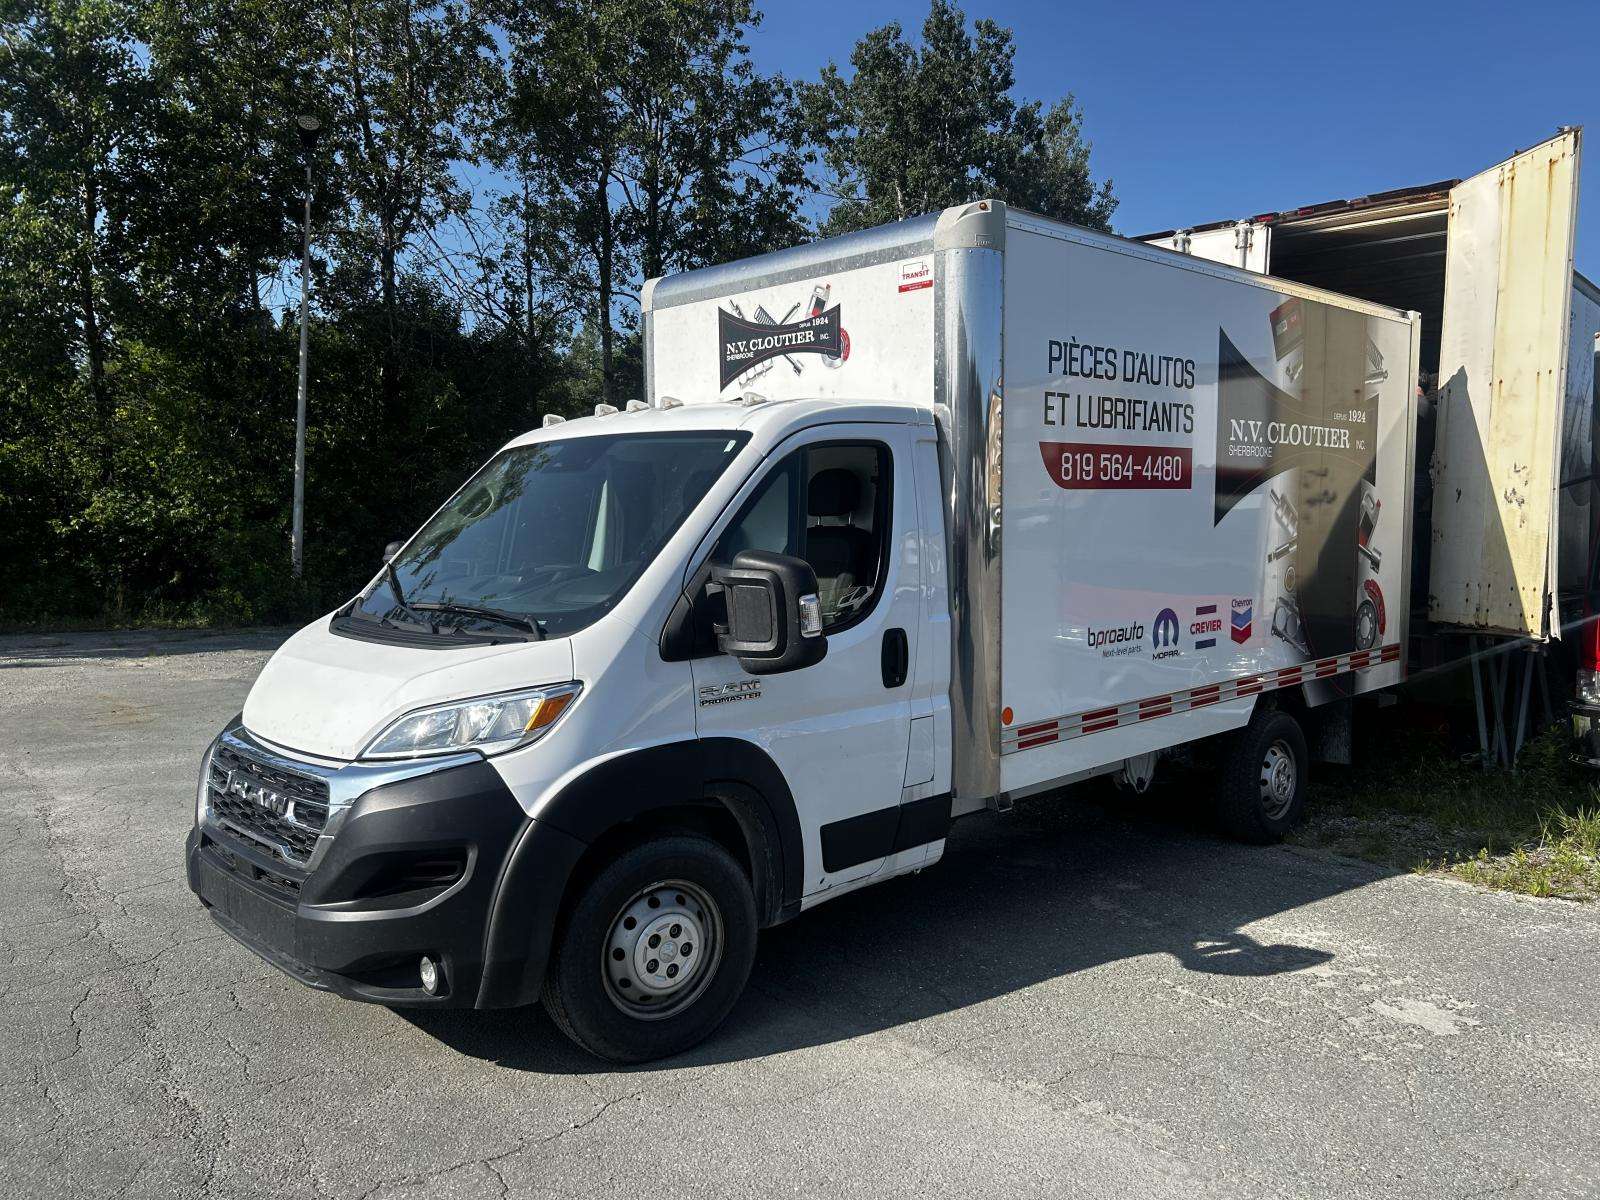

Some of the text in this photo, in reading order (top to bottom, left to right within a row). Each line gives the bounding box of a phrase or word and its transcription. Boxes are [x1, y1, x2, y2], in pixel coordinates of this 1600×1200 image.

[902, 269, 929, 280] TRANSIT
[812, 317, 829, 326] 1924
[726, 341, 747, 354] N.V.
[749, 330, 815, 351] CLOUTIER
[726, 352, 754, 361] SHERBROOKE
[1048, 336, 1195, 389] PIÈCES D'AUTOS
[1044, 391, 1194, 434] ET LUBRIFIANTS
[1348, 410, 1366, 423] 1924
[1230, 419, 1366, 450] N.V. CLOUTIER INC.
[1228, 444, 1273, 458] SHERBROOKE
[1061, 452, 1182, 481] 819 564-4480
[1231, 599, 1253, 608] Chevron
[1087, 620, 1144, 649] bproauto
[1189, 619, 1222, 635] CREVIER
[1102, 646, 1128, 658] Next-level
[1152, 649, 1179, 660] MOPAR
[699, 679, 761, 698] RAM
[699, 691, 761, 707] PROMASTER
[230, 780, 288, 817] RAM
